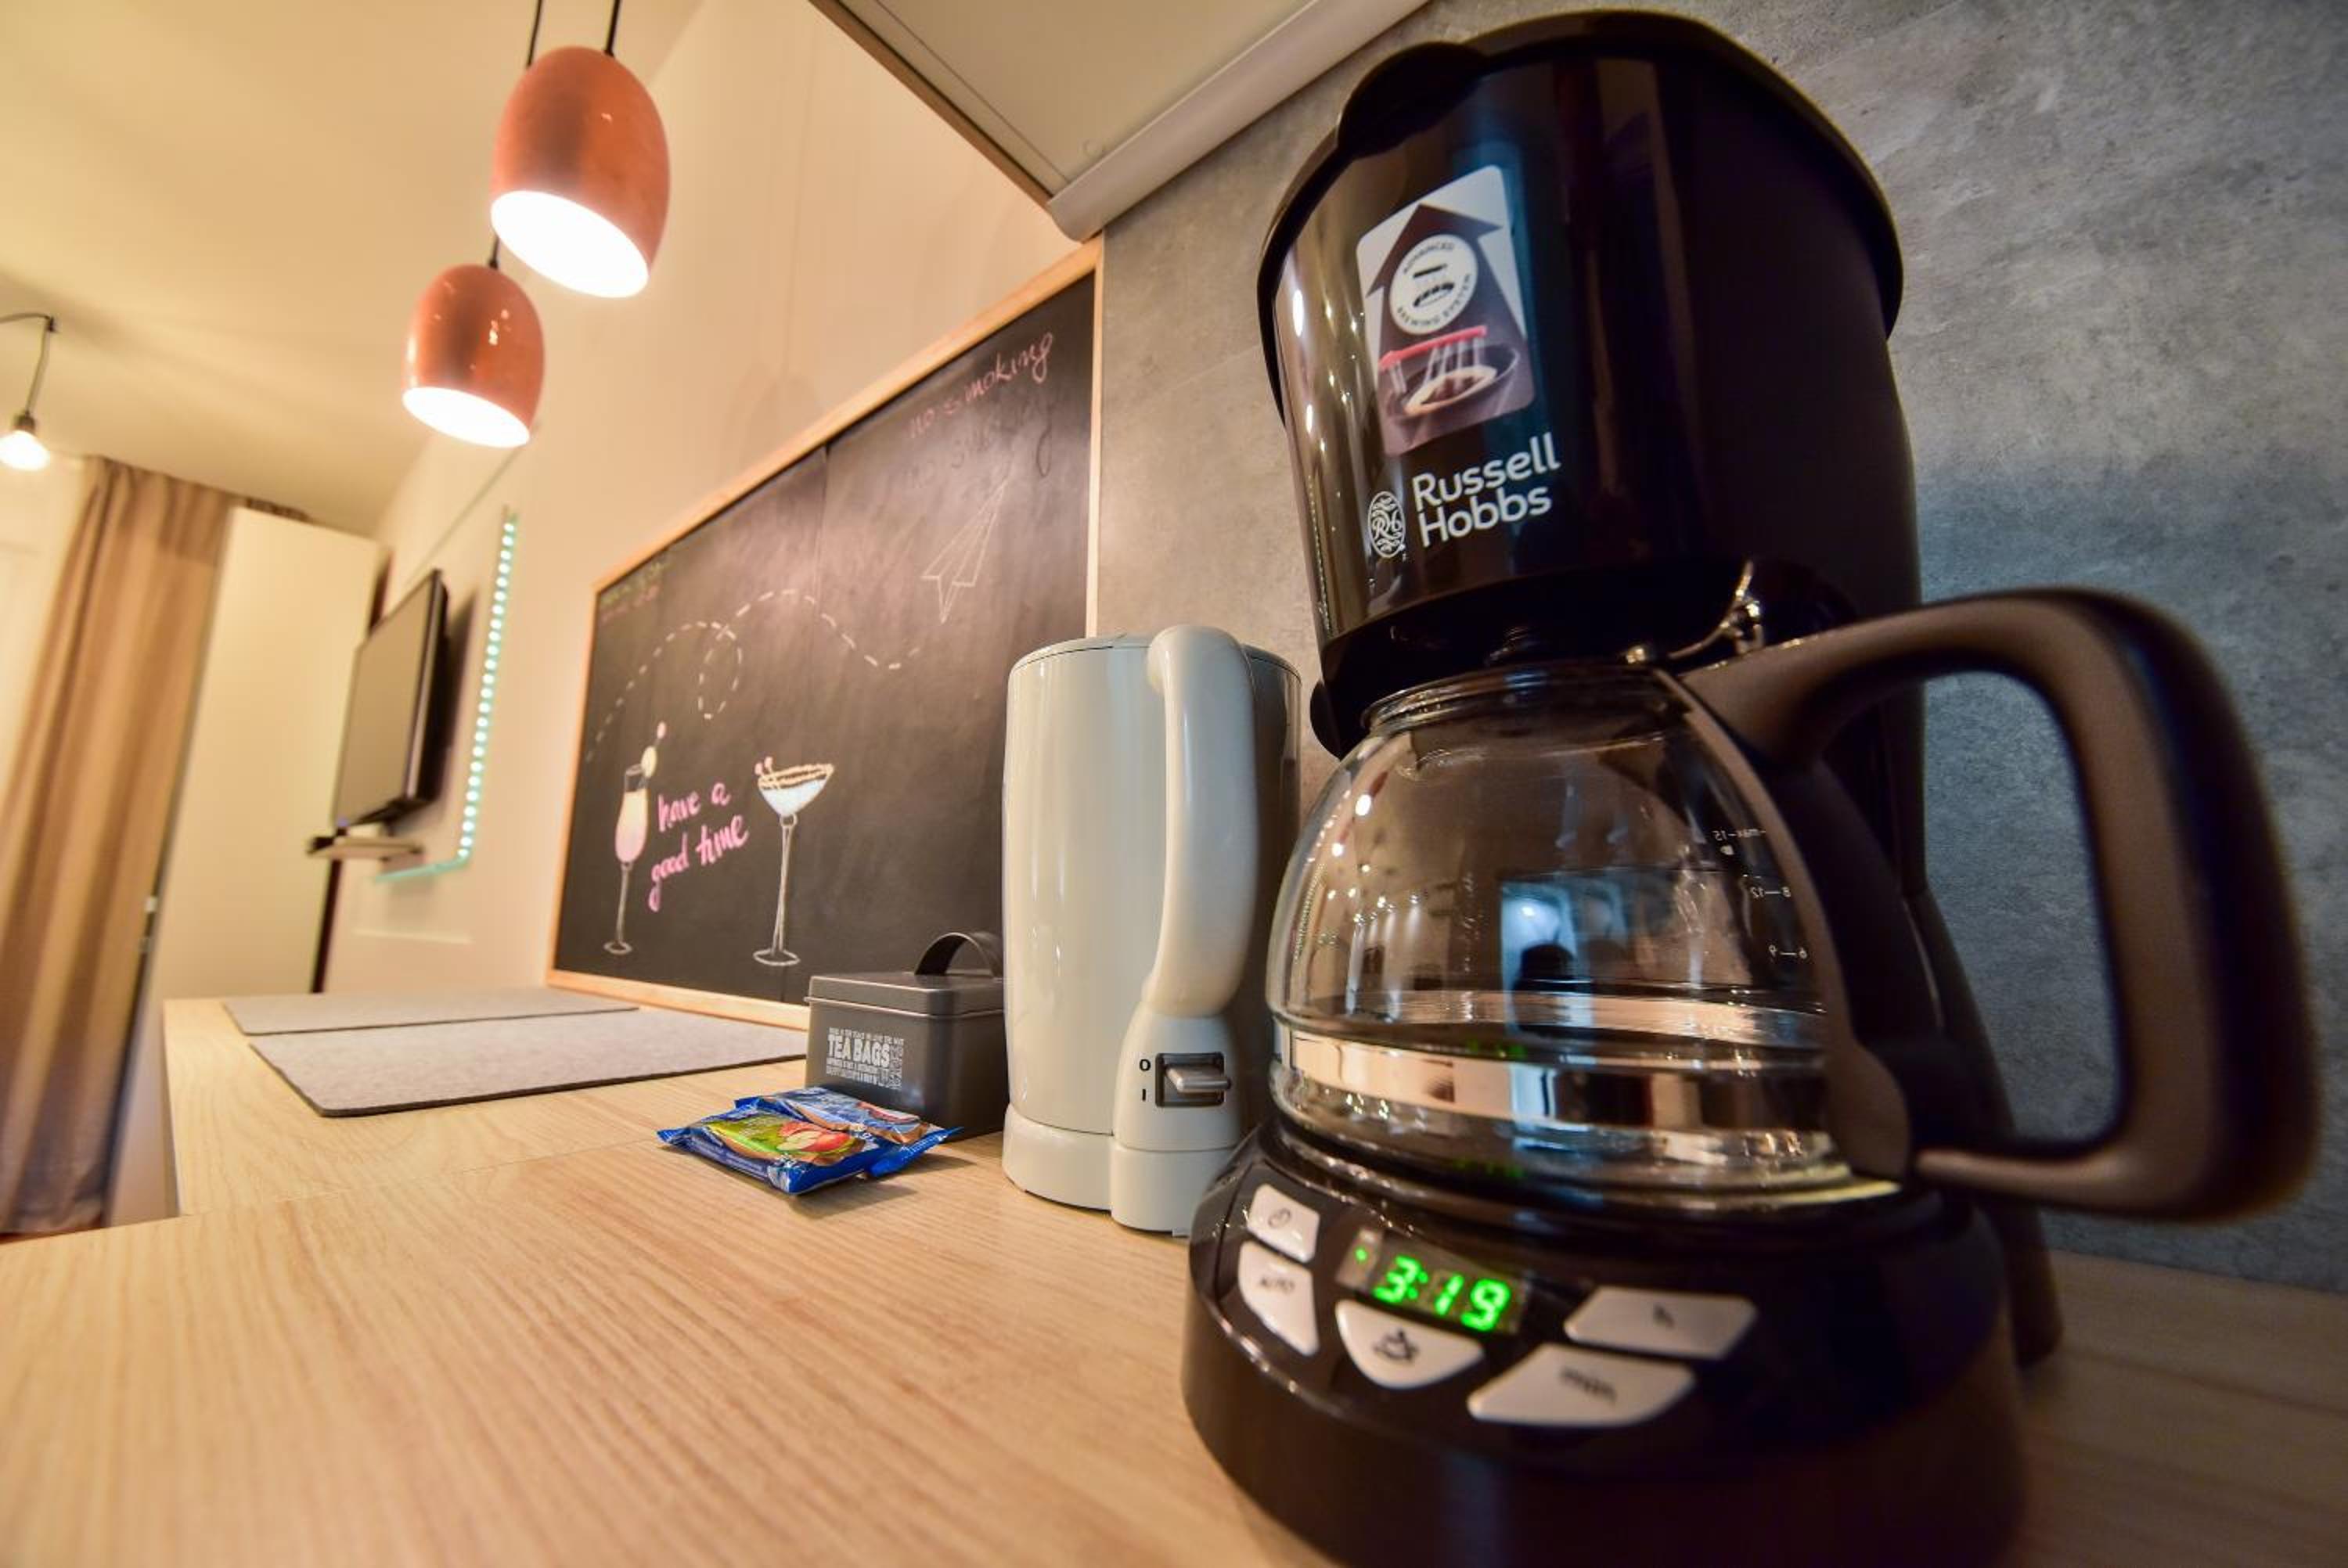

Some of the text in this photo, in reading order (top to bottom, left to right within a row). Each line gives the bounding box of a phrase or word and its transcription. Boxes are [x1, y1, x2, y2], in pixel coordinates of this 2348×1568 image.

[943, 332, 1053, 415] smoking
[1412, 432, 1562, 512] Russell
[1418, 486, 1552, 548] Hobbs
[657, 782, 732, 833] have a
[647, 815, 748, 912] good time
[827, 1034, 852, 1060] TEA
[852, 1038, 891, 1068] BAGS
[1372, 1254, 1511, 1331] 3:19
